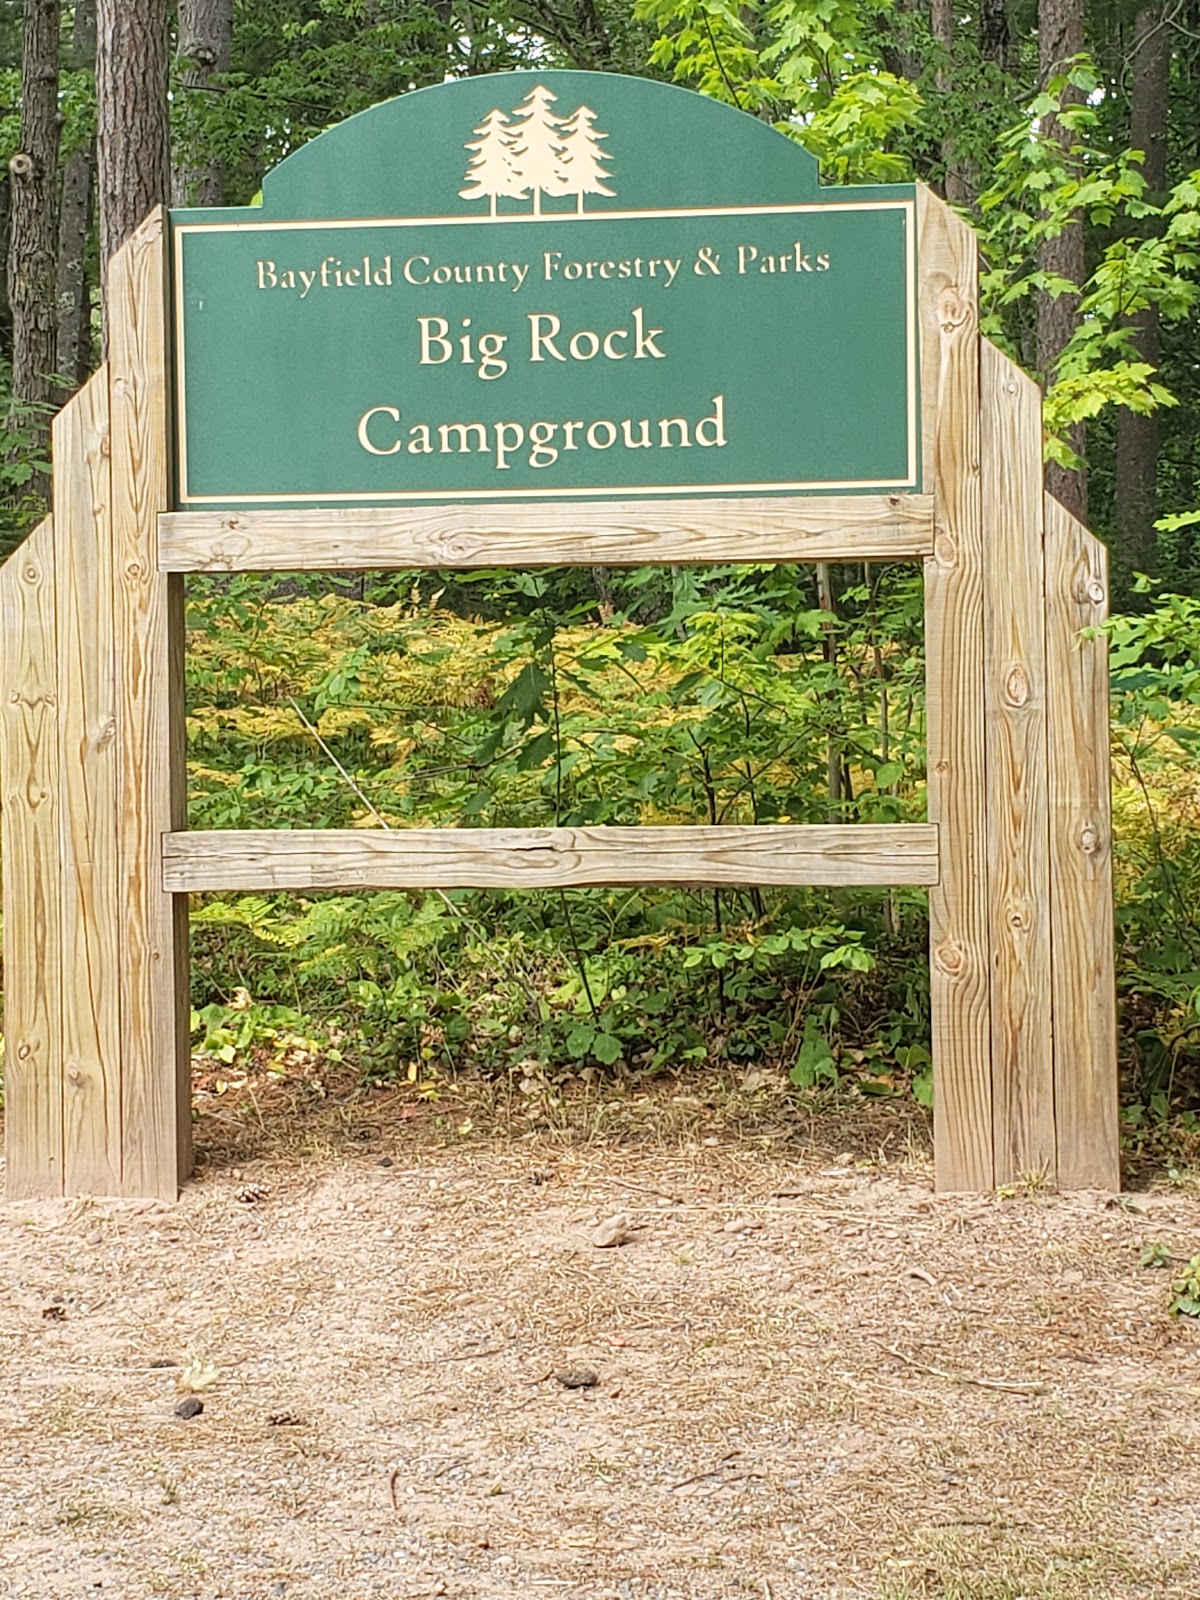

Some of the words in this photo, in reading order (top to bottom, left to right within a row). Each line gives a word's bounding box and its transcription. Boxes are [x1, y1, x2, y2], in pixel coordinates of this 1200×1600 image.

[256, 255, 394, 299] Bayfield
[403, 255, 530, 292] County
[543, 250, 682, 287] Forestry
[693, 245, 721, 276] &
[737, 243, 831, 274] Parks
[417, 315, 508, 380] Big
[527, 306, 666, 363] Rock
[356, 395, 727, 470] Campground
